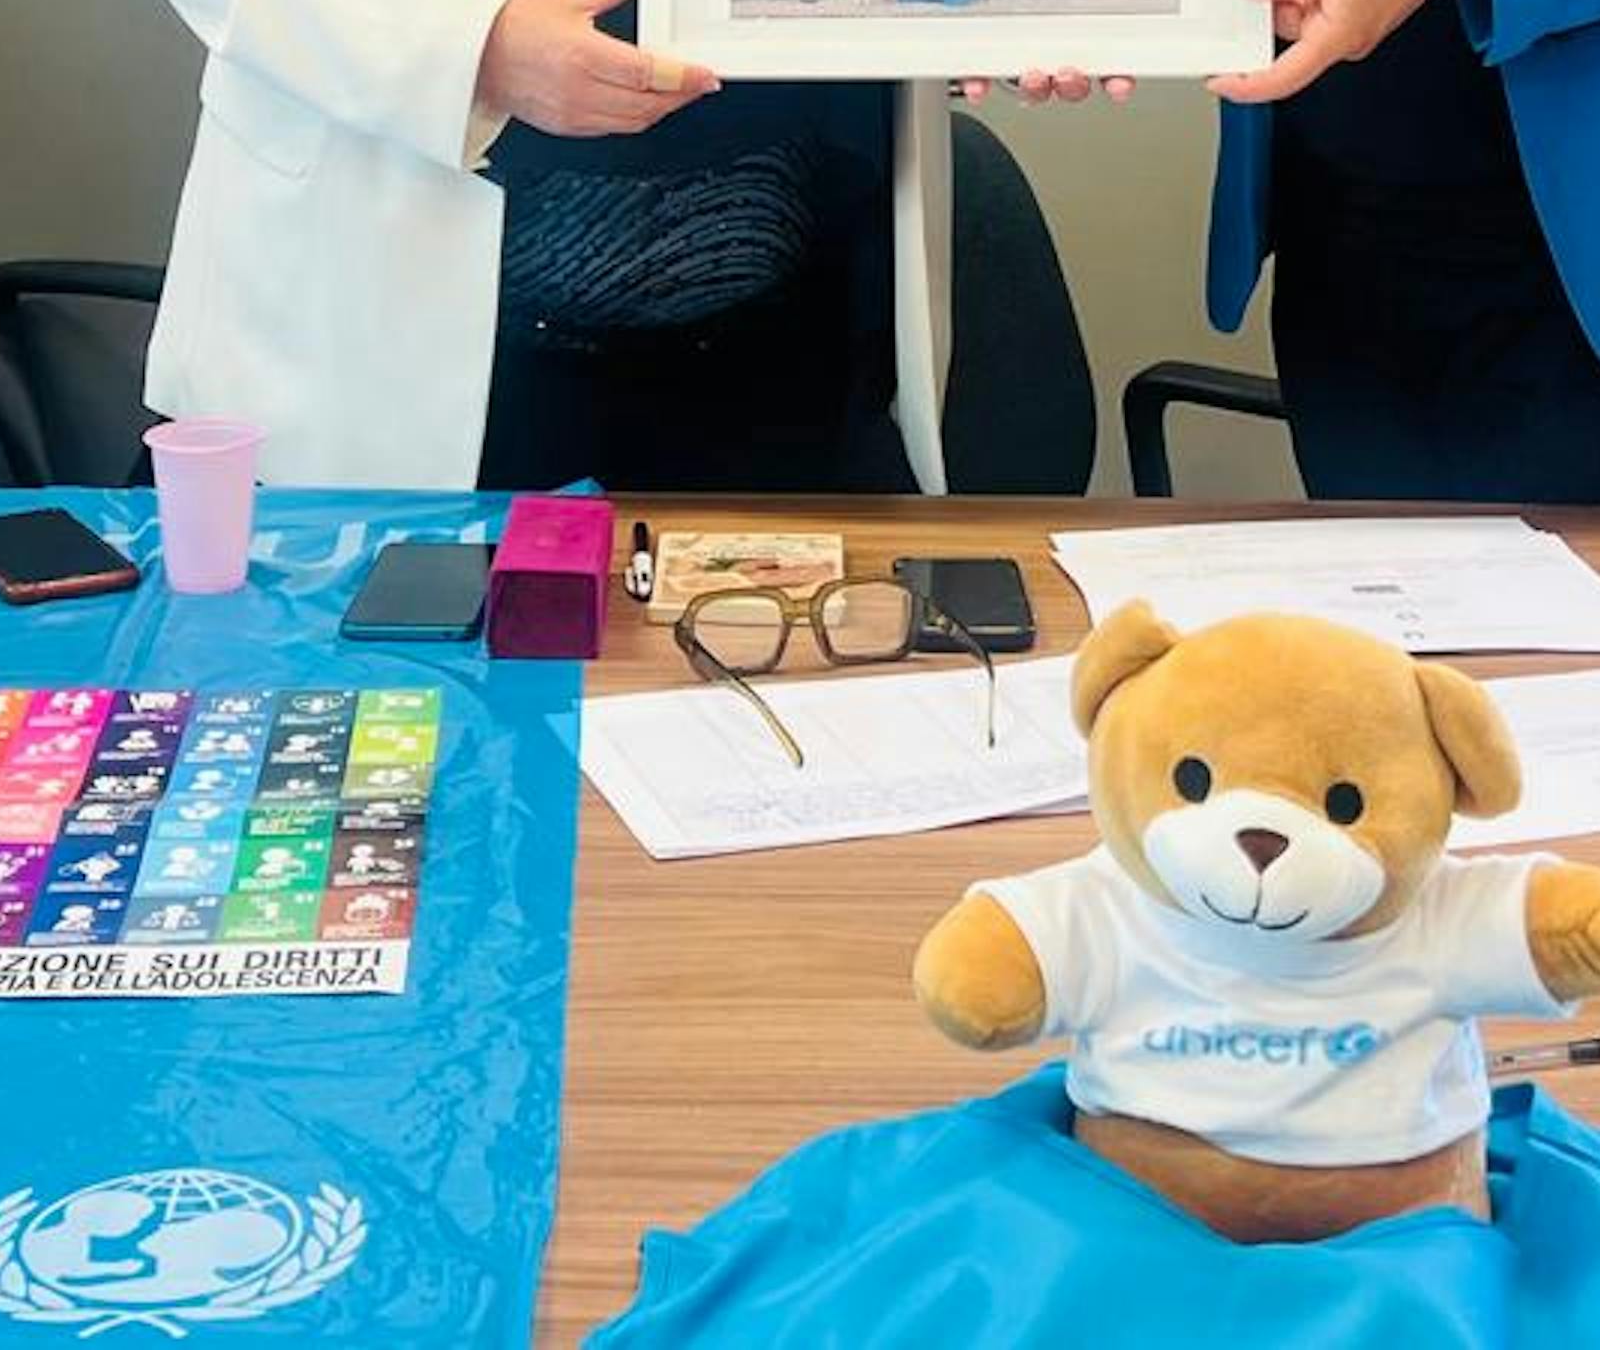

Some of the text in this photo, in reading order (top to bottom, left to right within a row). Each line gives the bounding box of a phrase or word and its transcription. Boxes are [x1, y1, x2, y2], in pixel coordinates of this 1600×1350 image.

[151, 952, 221, 972] SUI
[244, 948, 382, 970] DIRITTI
[46, 973, 66, 992] E
[1142, 1022, 1320, 1066] unicef
